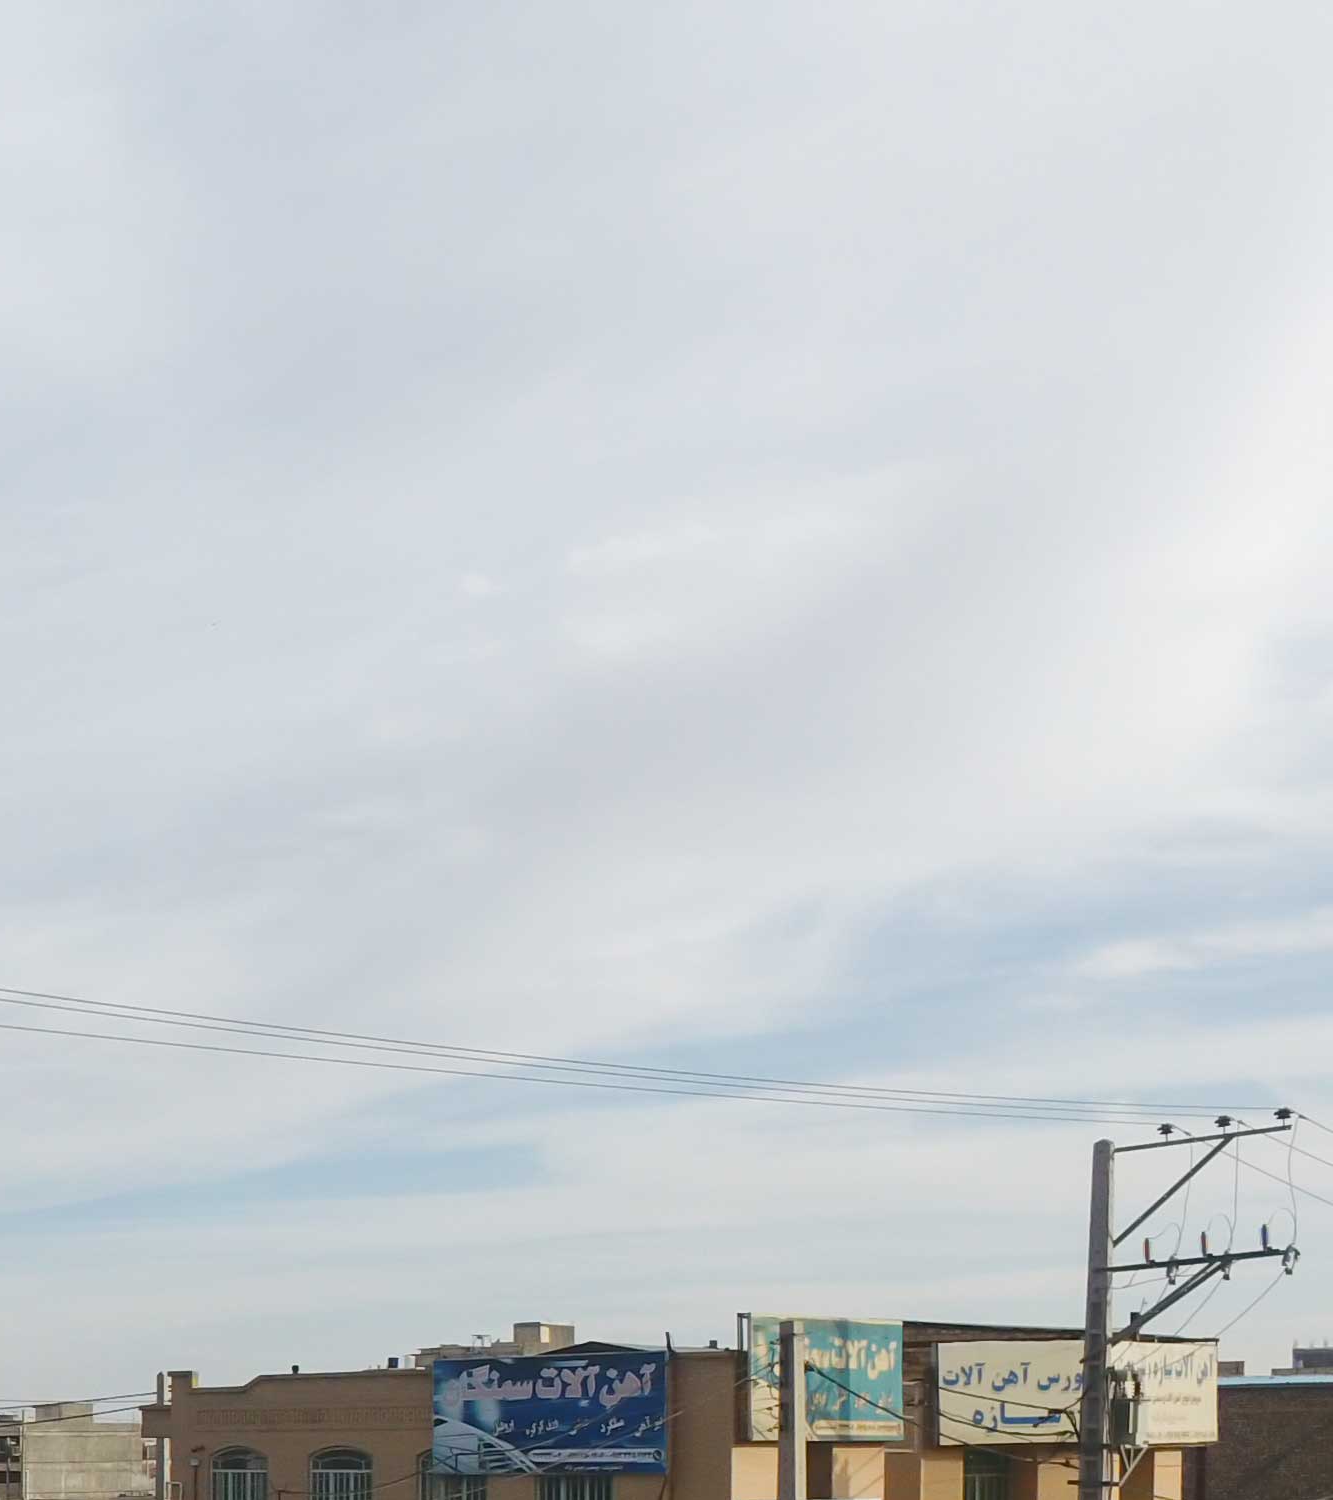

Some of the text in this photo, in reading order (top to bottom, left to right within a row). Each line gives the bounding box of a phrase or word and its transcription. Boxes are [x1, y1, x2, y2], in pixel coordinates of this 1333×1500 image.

[535, 1365, 600, 1399] آلات
[599, 1363, 656, 1409] آهن
[942, 1362, 1083, 1392] ورس آهن آلات
